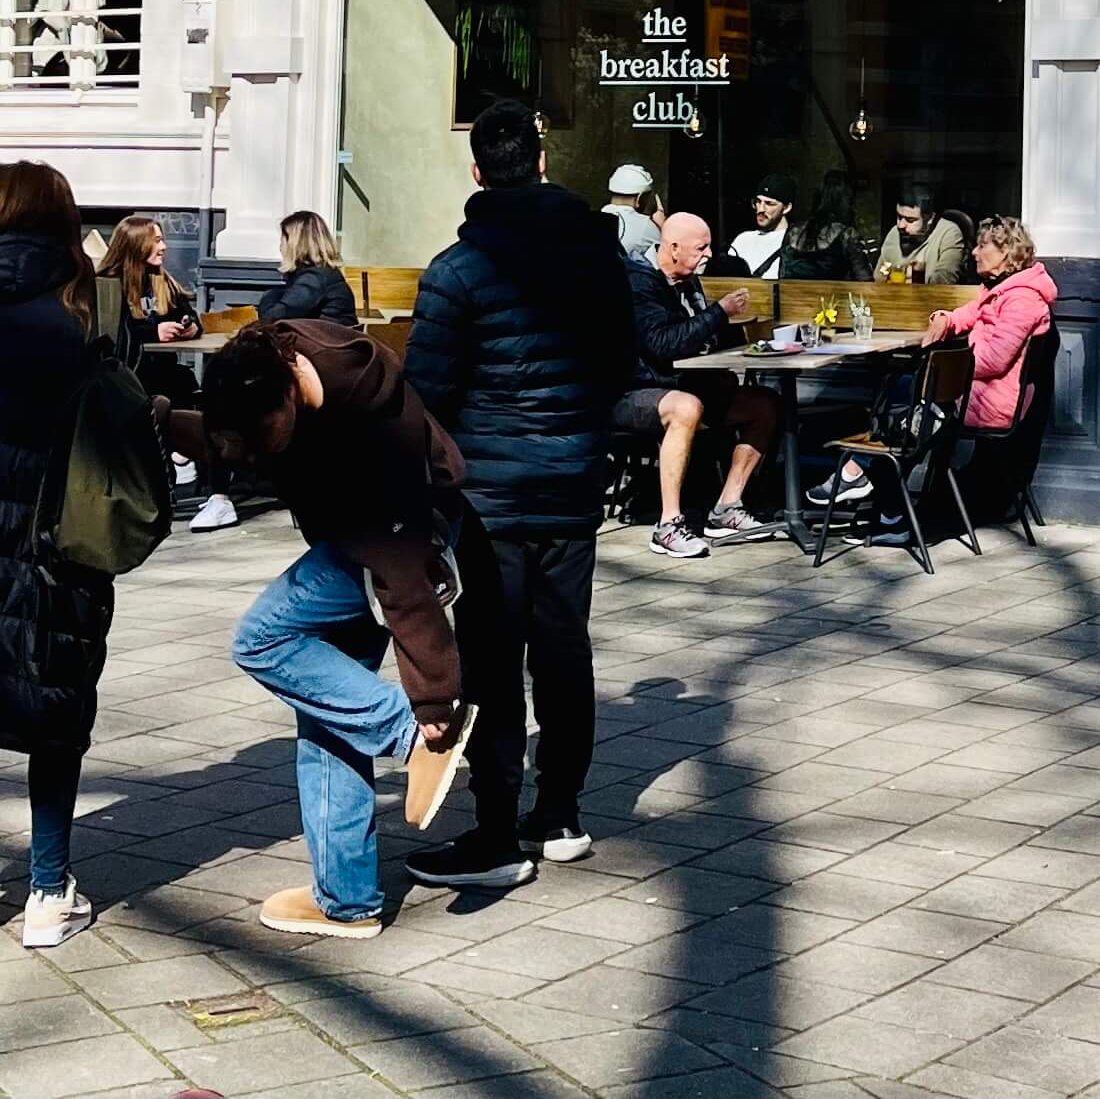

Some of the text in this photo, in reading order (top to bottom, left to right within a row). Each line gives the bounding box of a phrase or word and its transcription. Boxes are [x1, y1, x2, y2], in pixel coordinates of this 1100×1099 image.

[642, 7, 687, 36] the
[600, 48, 730, 78] breakfast
[632, 92, 694, 121] club
